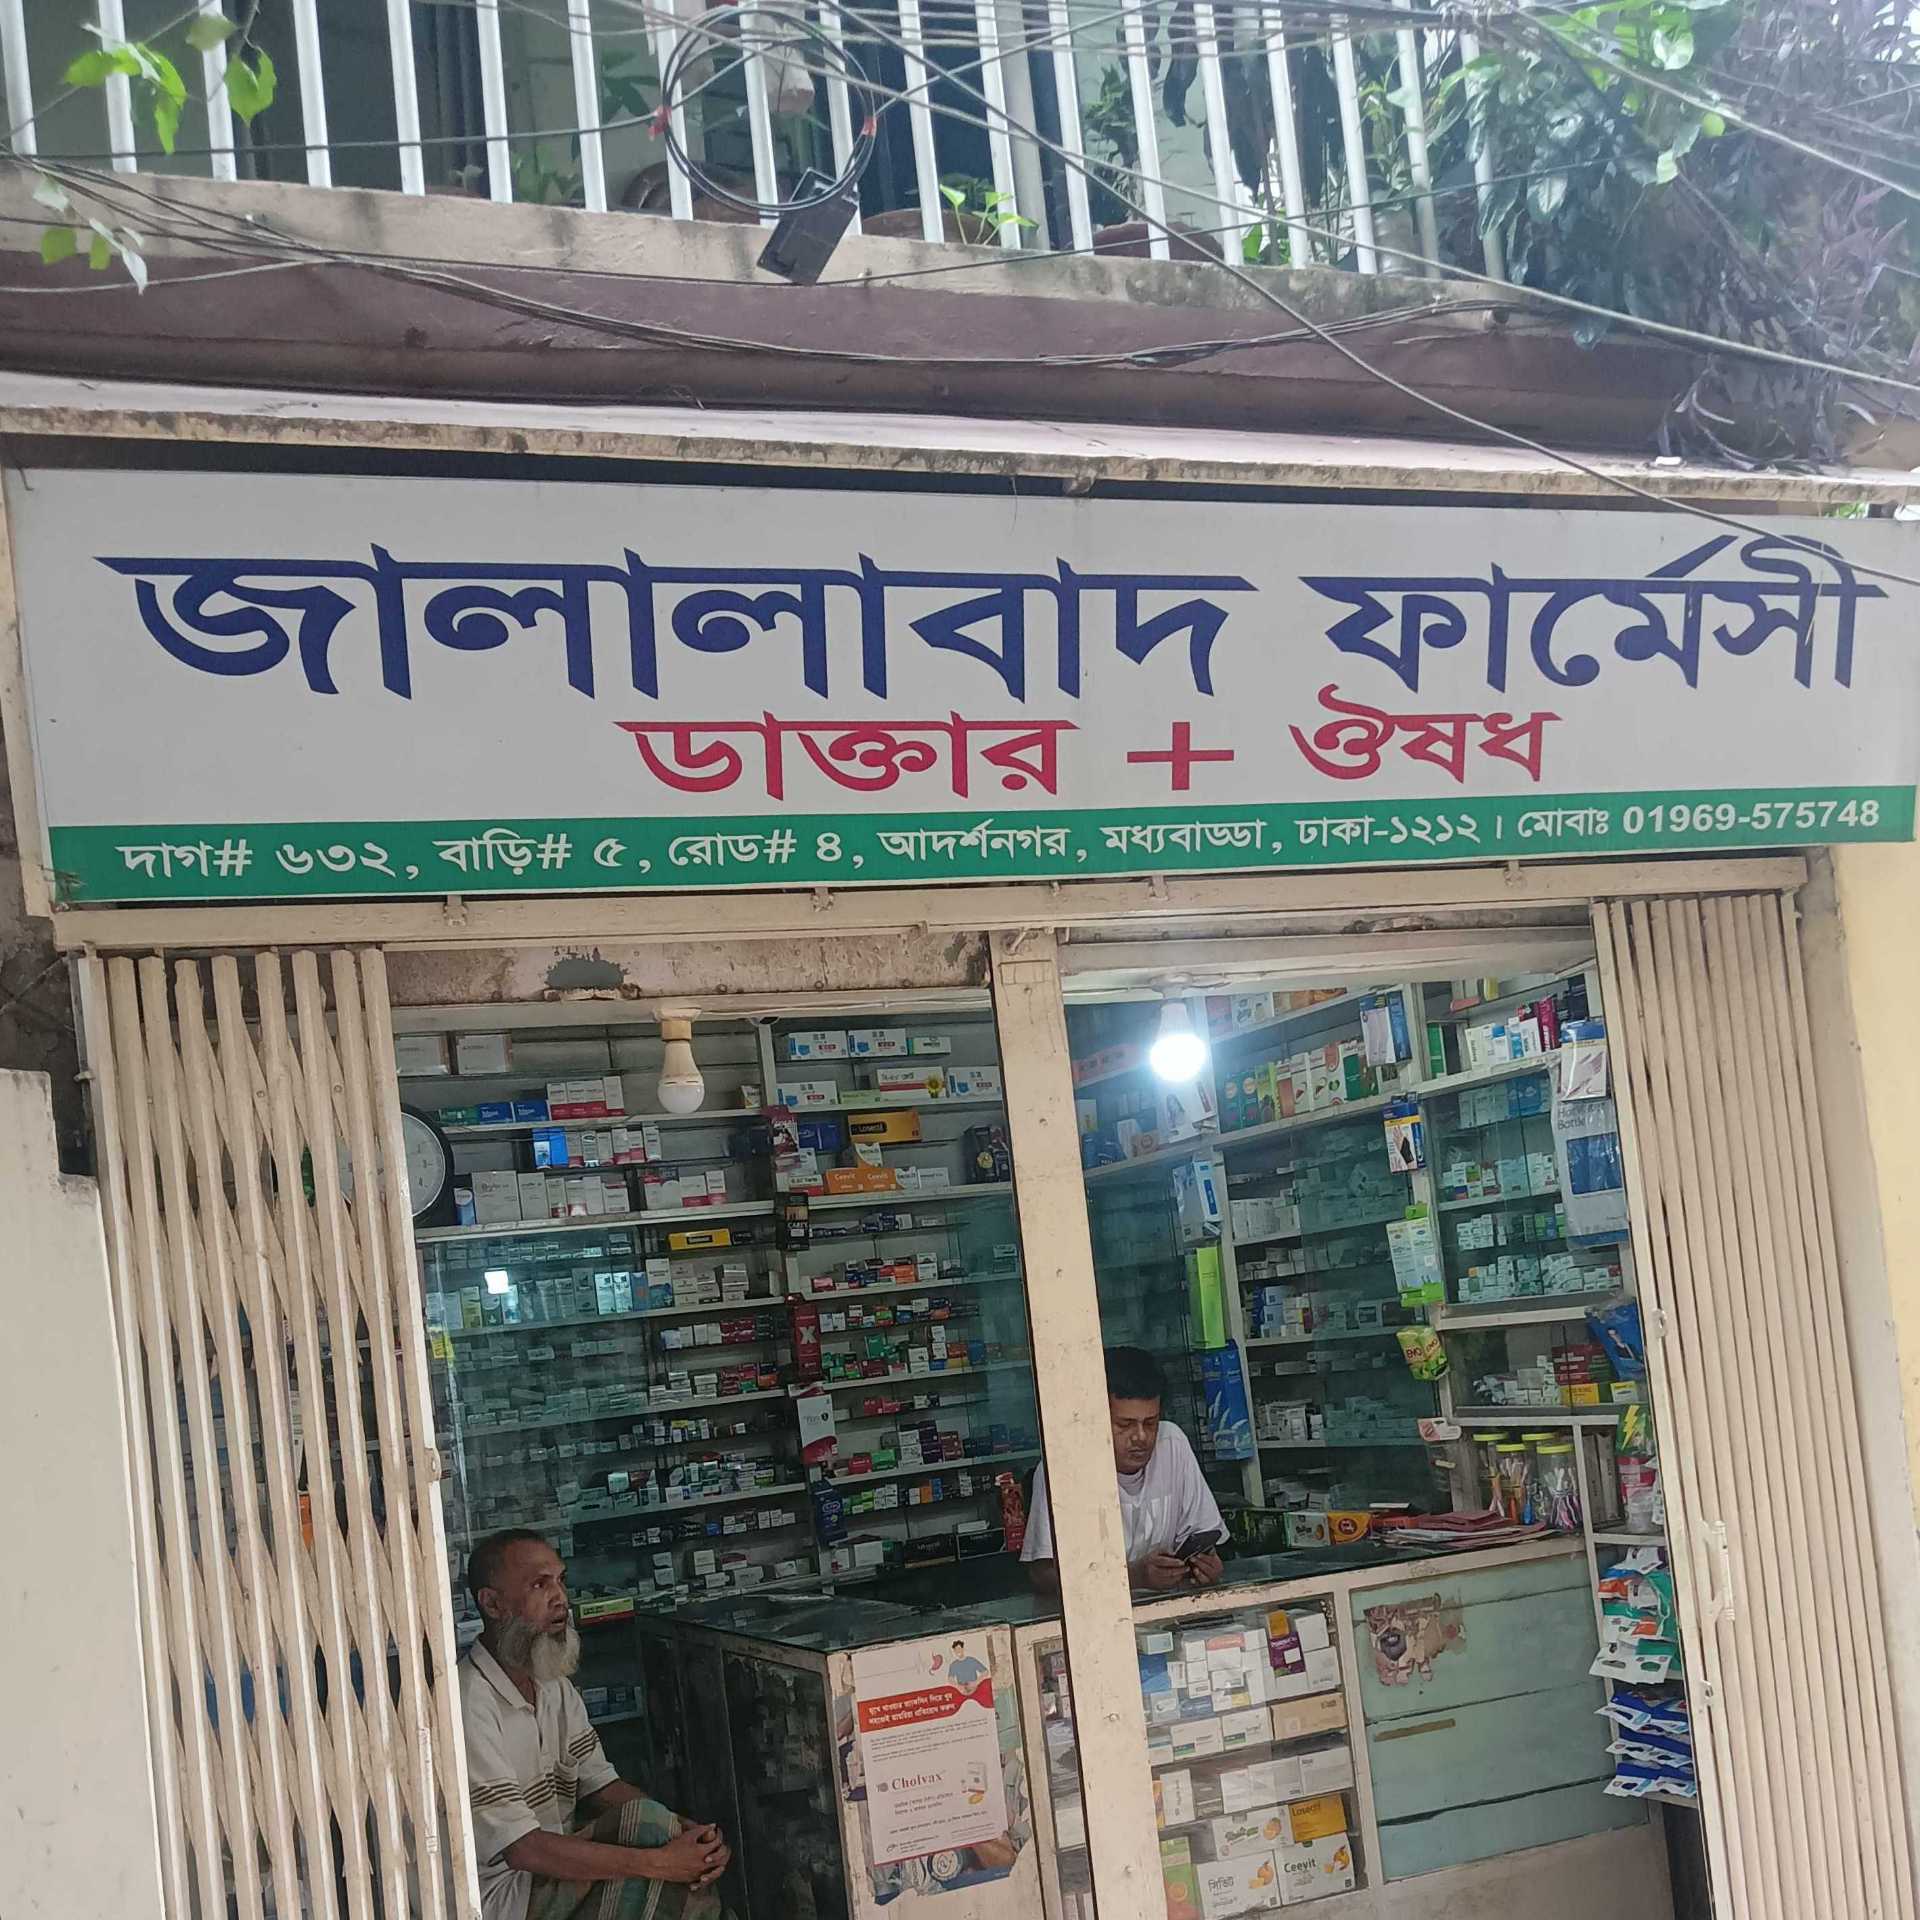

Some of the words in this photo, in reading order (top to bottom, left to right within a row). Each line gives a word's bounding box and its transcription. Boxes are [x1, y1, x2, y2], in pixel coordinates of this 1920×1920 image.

[93, 543, 1258, 703] জালালাবাদ
[1298, 533, 1890, 692] ফার্মেসী
[614, 711, 1080, 800] ডাক্তার
[1289, 683, 1562, 784] ঔষধ
[115, 838, 252, 878] দাগ#
[276, 841, 420, 880] ৬৩২,
[432, 827, 573, 876] বাড়ি#
[668, 829, 797, 867] রোড#
[877, 819, 1088, 864] আদর্শনগর,
[1099, 818, 1283, 856] মধ্যবাড্ডা,
[1294, 813, 1481, 848] ঢাকা-১২১২
[1622, 799, 1881, 835] 01969-575748
[891, 1774, 943, 1791] Cholvax
